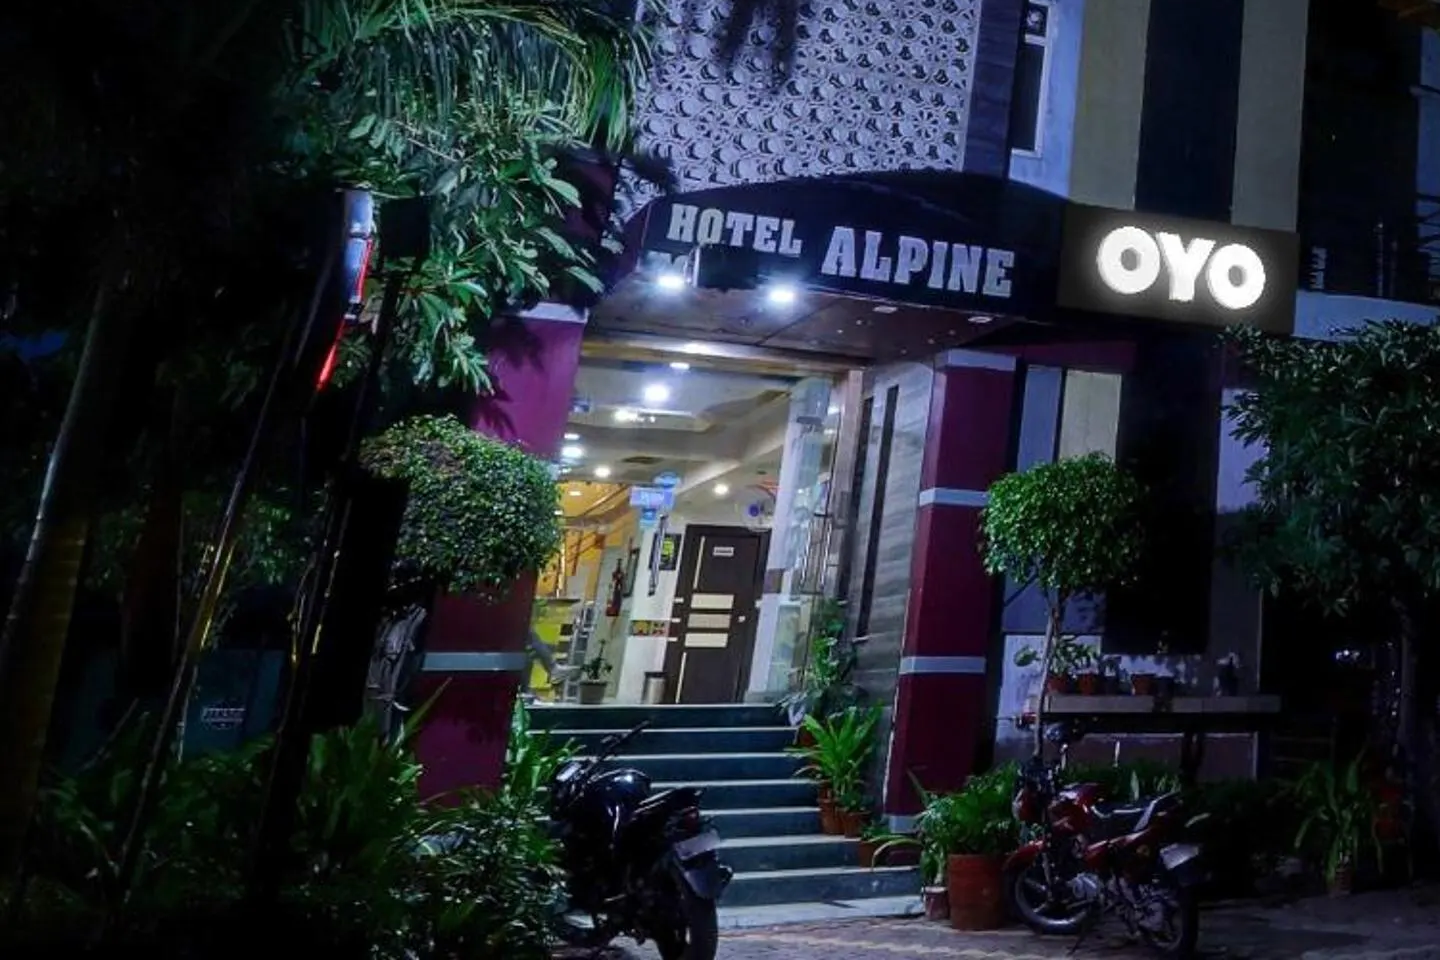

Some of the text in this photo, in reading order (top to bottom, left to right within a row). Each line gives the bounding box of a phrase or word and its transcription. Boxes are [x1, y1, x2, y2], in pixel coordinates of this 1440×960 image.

[667, 203, 1015, 298] HOTEL ALPINE
[1097, 226, 1266, 309] OYO
